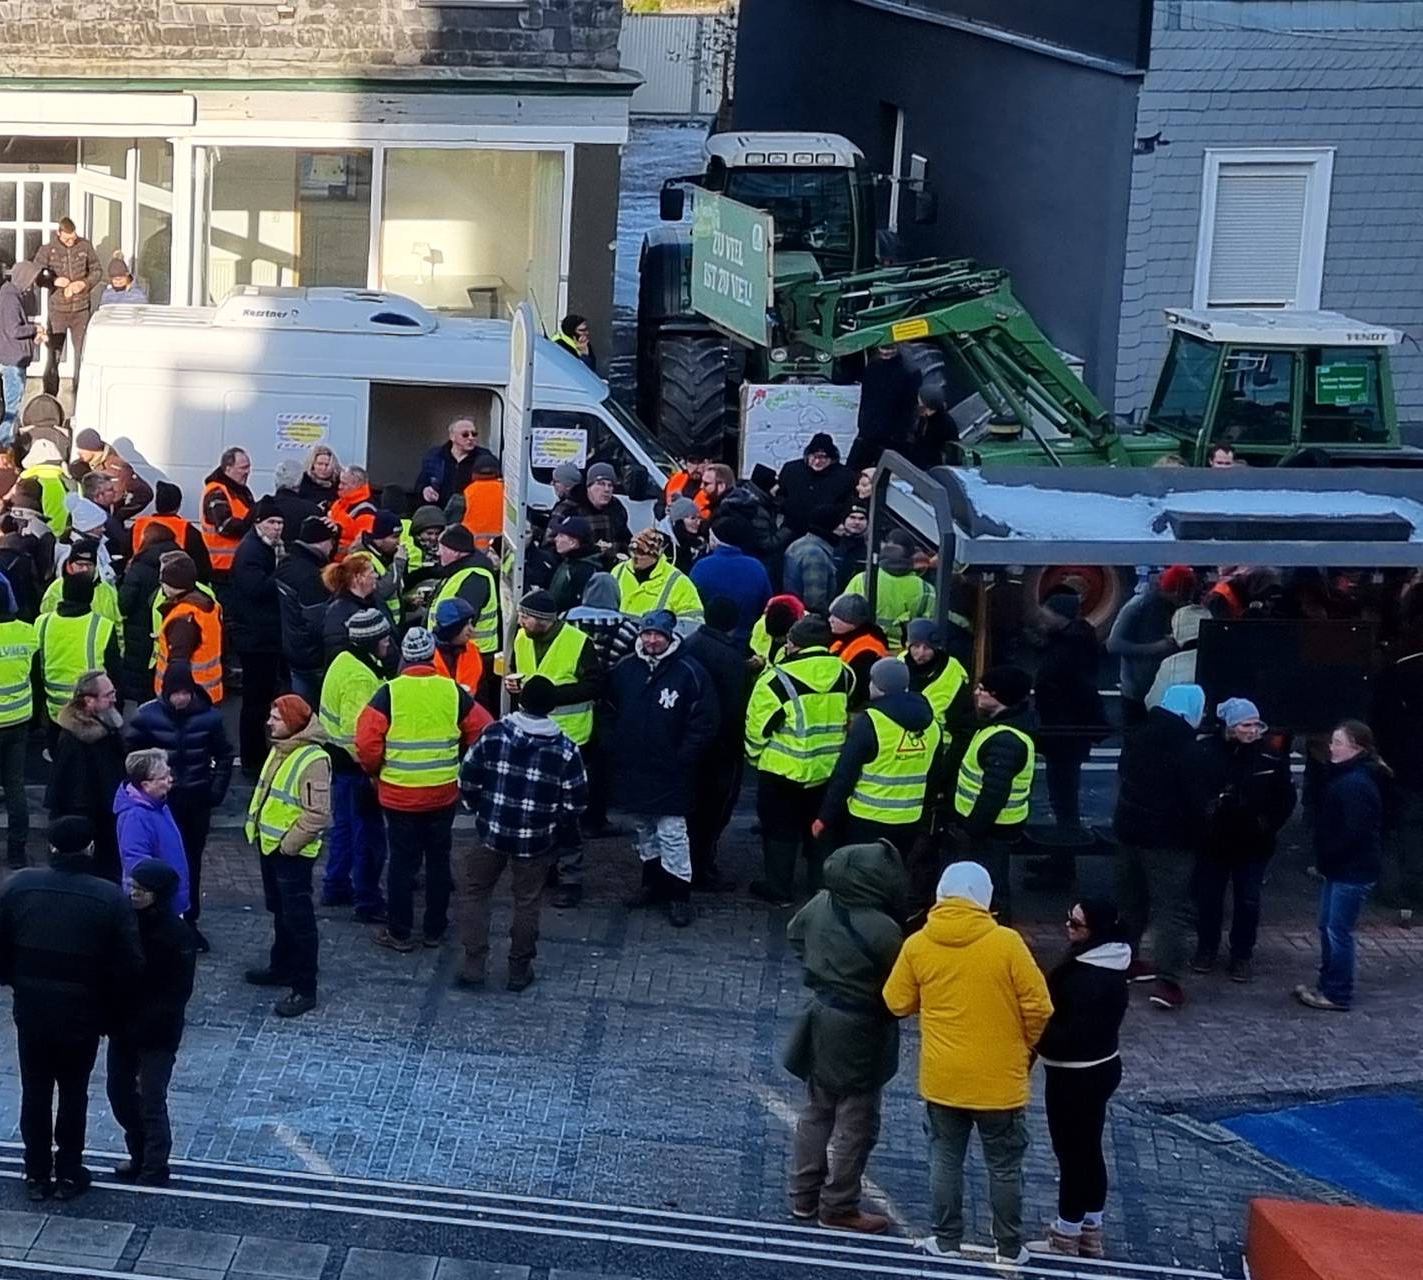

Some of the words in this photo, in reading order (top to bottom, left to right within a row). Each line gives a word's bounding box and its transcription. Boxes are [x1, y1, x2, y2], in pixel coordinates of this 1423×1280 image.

[712, 230, 725, 257] ZU
[725, 234, 744, 266] VIEL
[703, 261, 718, 291] IST
[717, 267, 730, 296] ZU
[1346, 333, 1387, 341] FENDT
